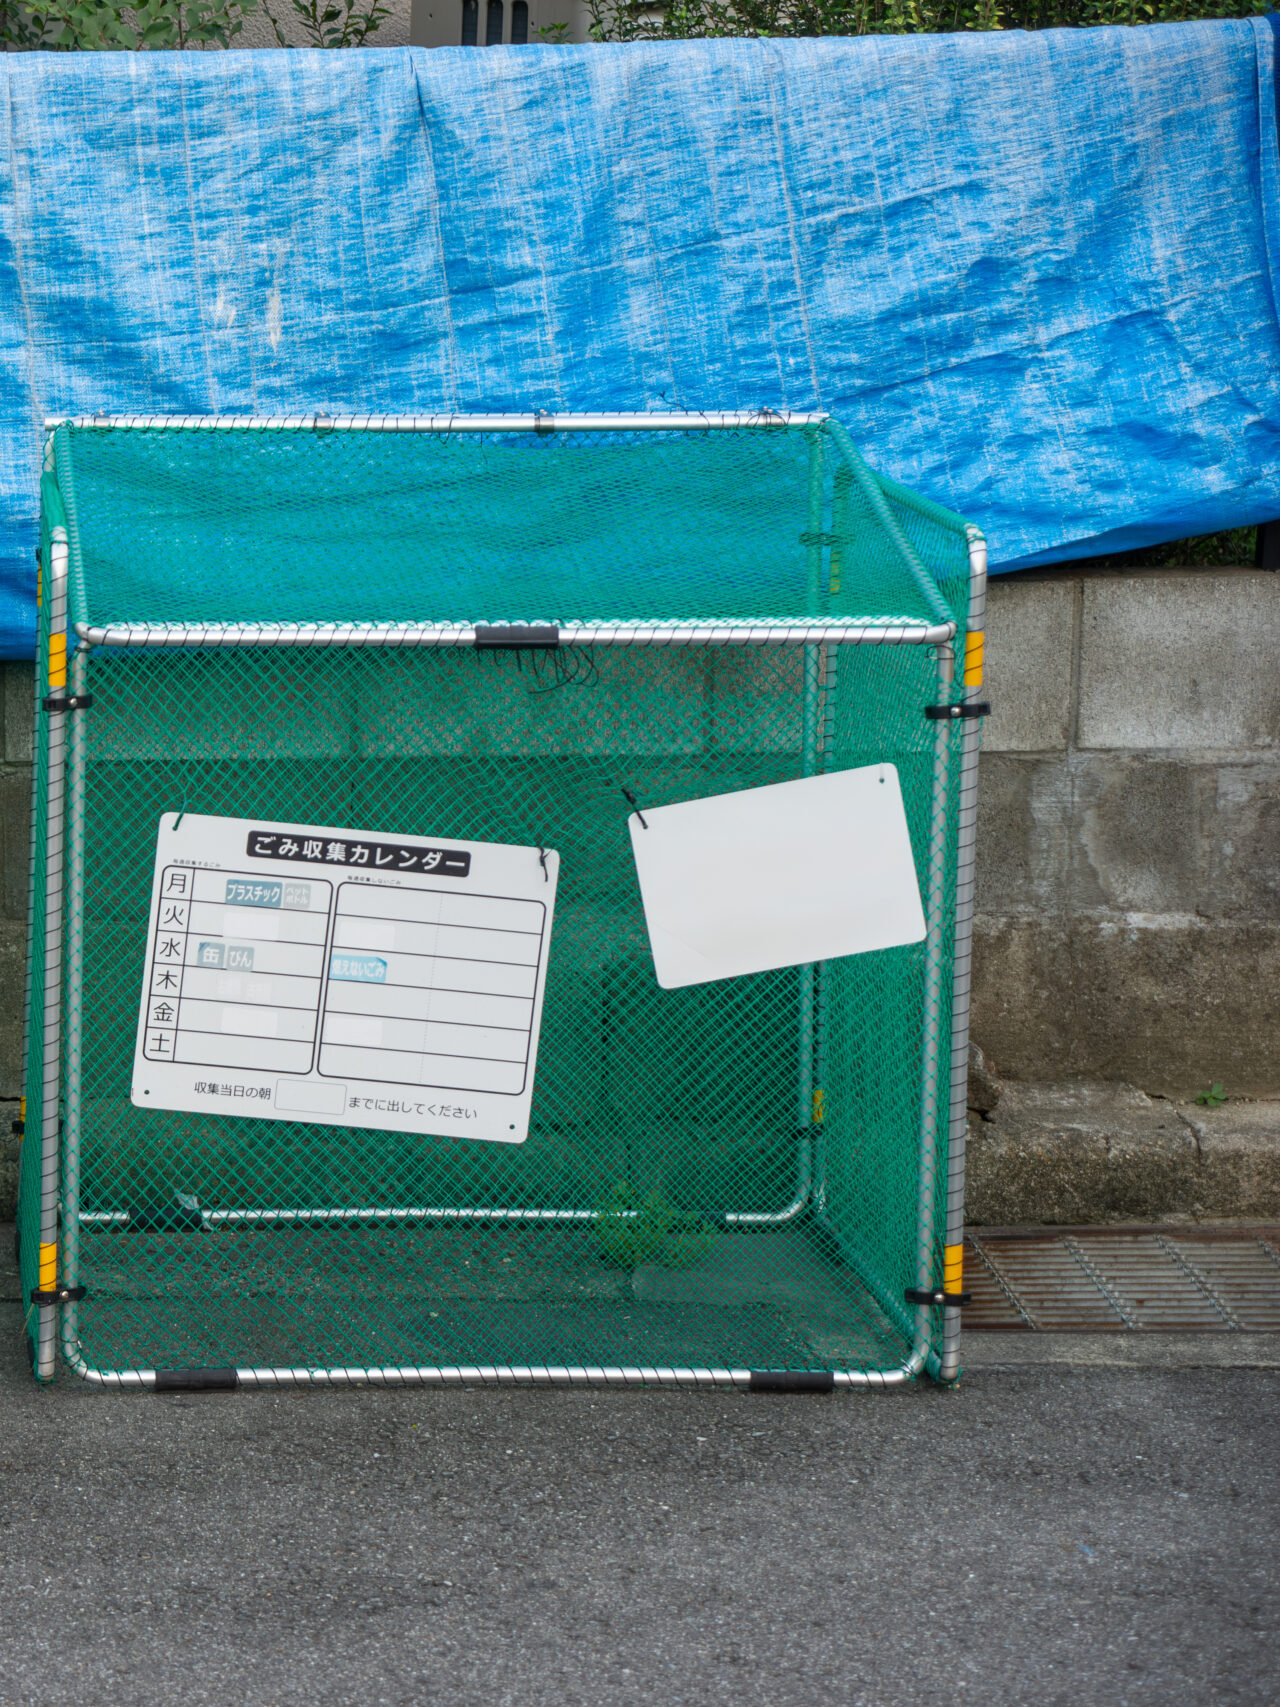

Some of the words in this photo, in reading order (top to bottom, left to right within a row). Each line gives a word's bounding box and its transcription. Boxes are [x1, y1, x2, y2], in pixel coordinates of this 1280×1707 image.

[254, 834, 467, 871] ごみ収集カレンダー
[166, 873, 188, 894] 月
[227, 884, 281, 902] プラスチック
[162, 904, 186, 926] 火
[159, 937, 182, 958] 水
[202, 946, 221, 964] 缶
[155, 970, 179, 990] 木
[152, 1001, 175, 1022] 金
[149, 1034, 171, 1053] 土
[193, 1080, 272, 1101] 収集当日の朝
[348, 1095, 478, 1120] までに出してください
